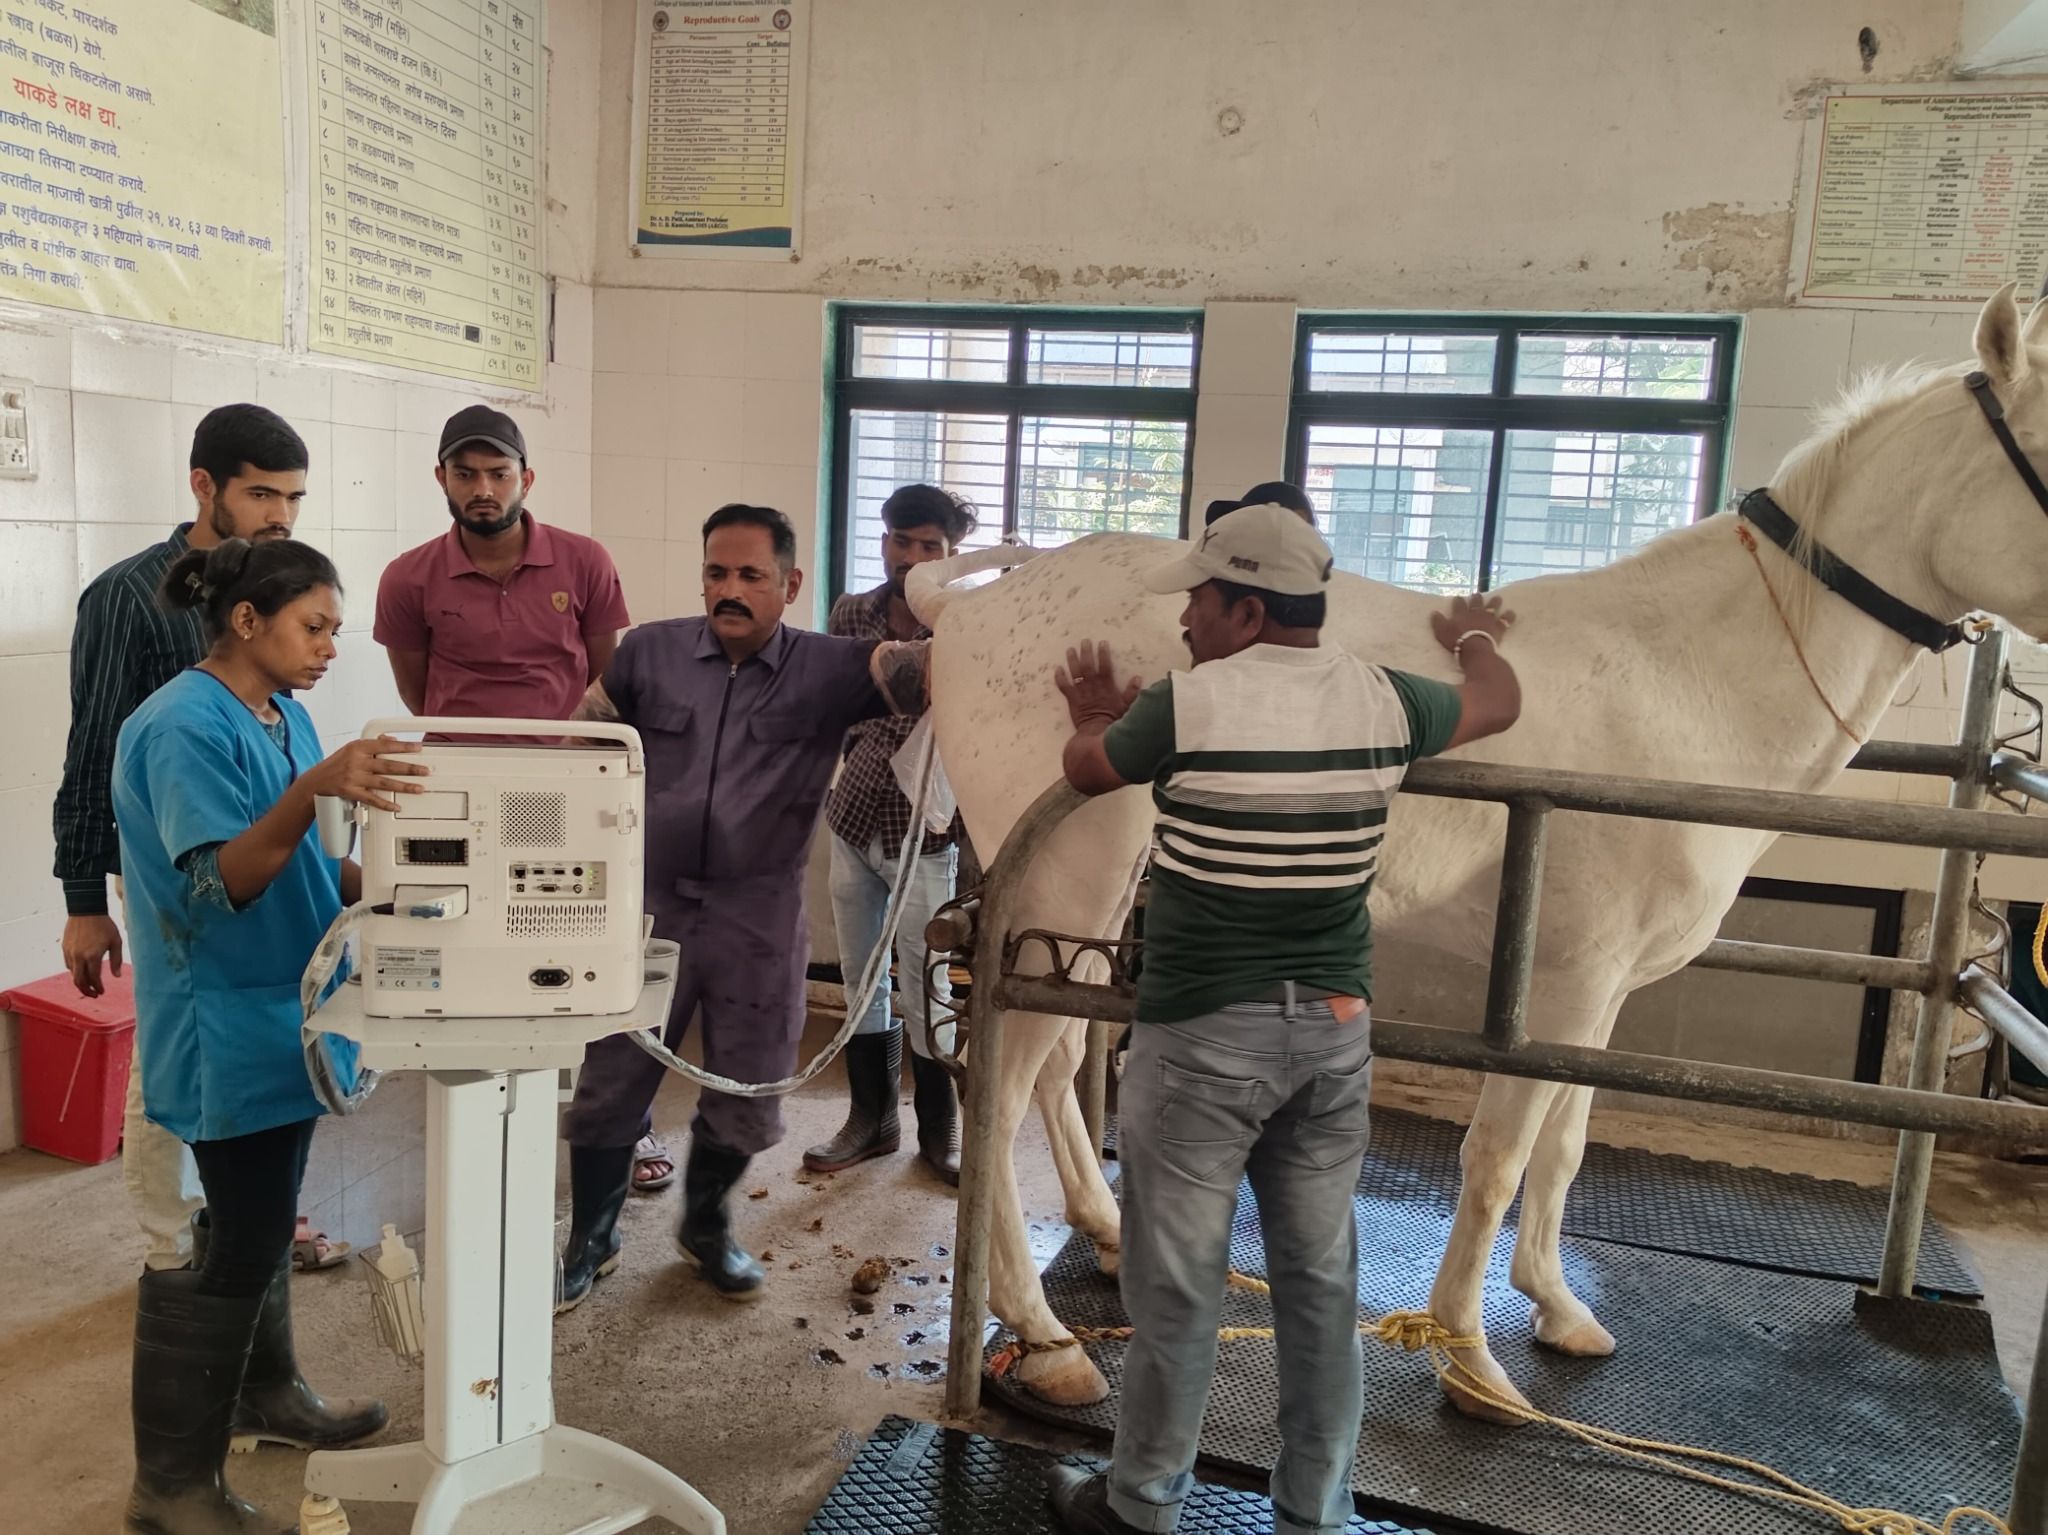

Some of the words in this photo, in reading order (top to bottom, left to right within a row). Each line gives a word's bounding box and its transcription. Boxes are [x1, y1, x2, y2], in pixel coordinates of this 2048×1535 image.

[319, 10, 326, 24] ४
[683, 15, 736, 26] Reproductive
[738, 15, 761, 25] Goals
[69, 61, 122, 95] चिकटलेला
[12, 77, 58, 109] याकडे
[63, 95, 92, 121] लक्ष
[97, 106, 121, 130] द्या.
[46, 120, 86, 148] निरीक्षण
[90, 138, 121, 159] करावे.
[118, 174, 147, 194] करावे.
[324, 183, 336, 197] १०
[88, 194, 113, 213] खात्री
[93, 223, 99, 239] ३
[31, 238, 39, 252] व
[81, 249, 110, 267] आहार
[325, 239, 337, 254] १२
[23, 262, 46, 283] निगा
